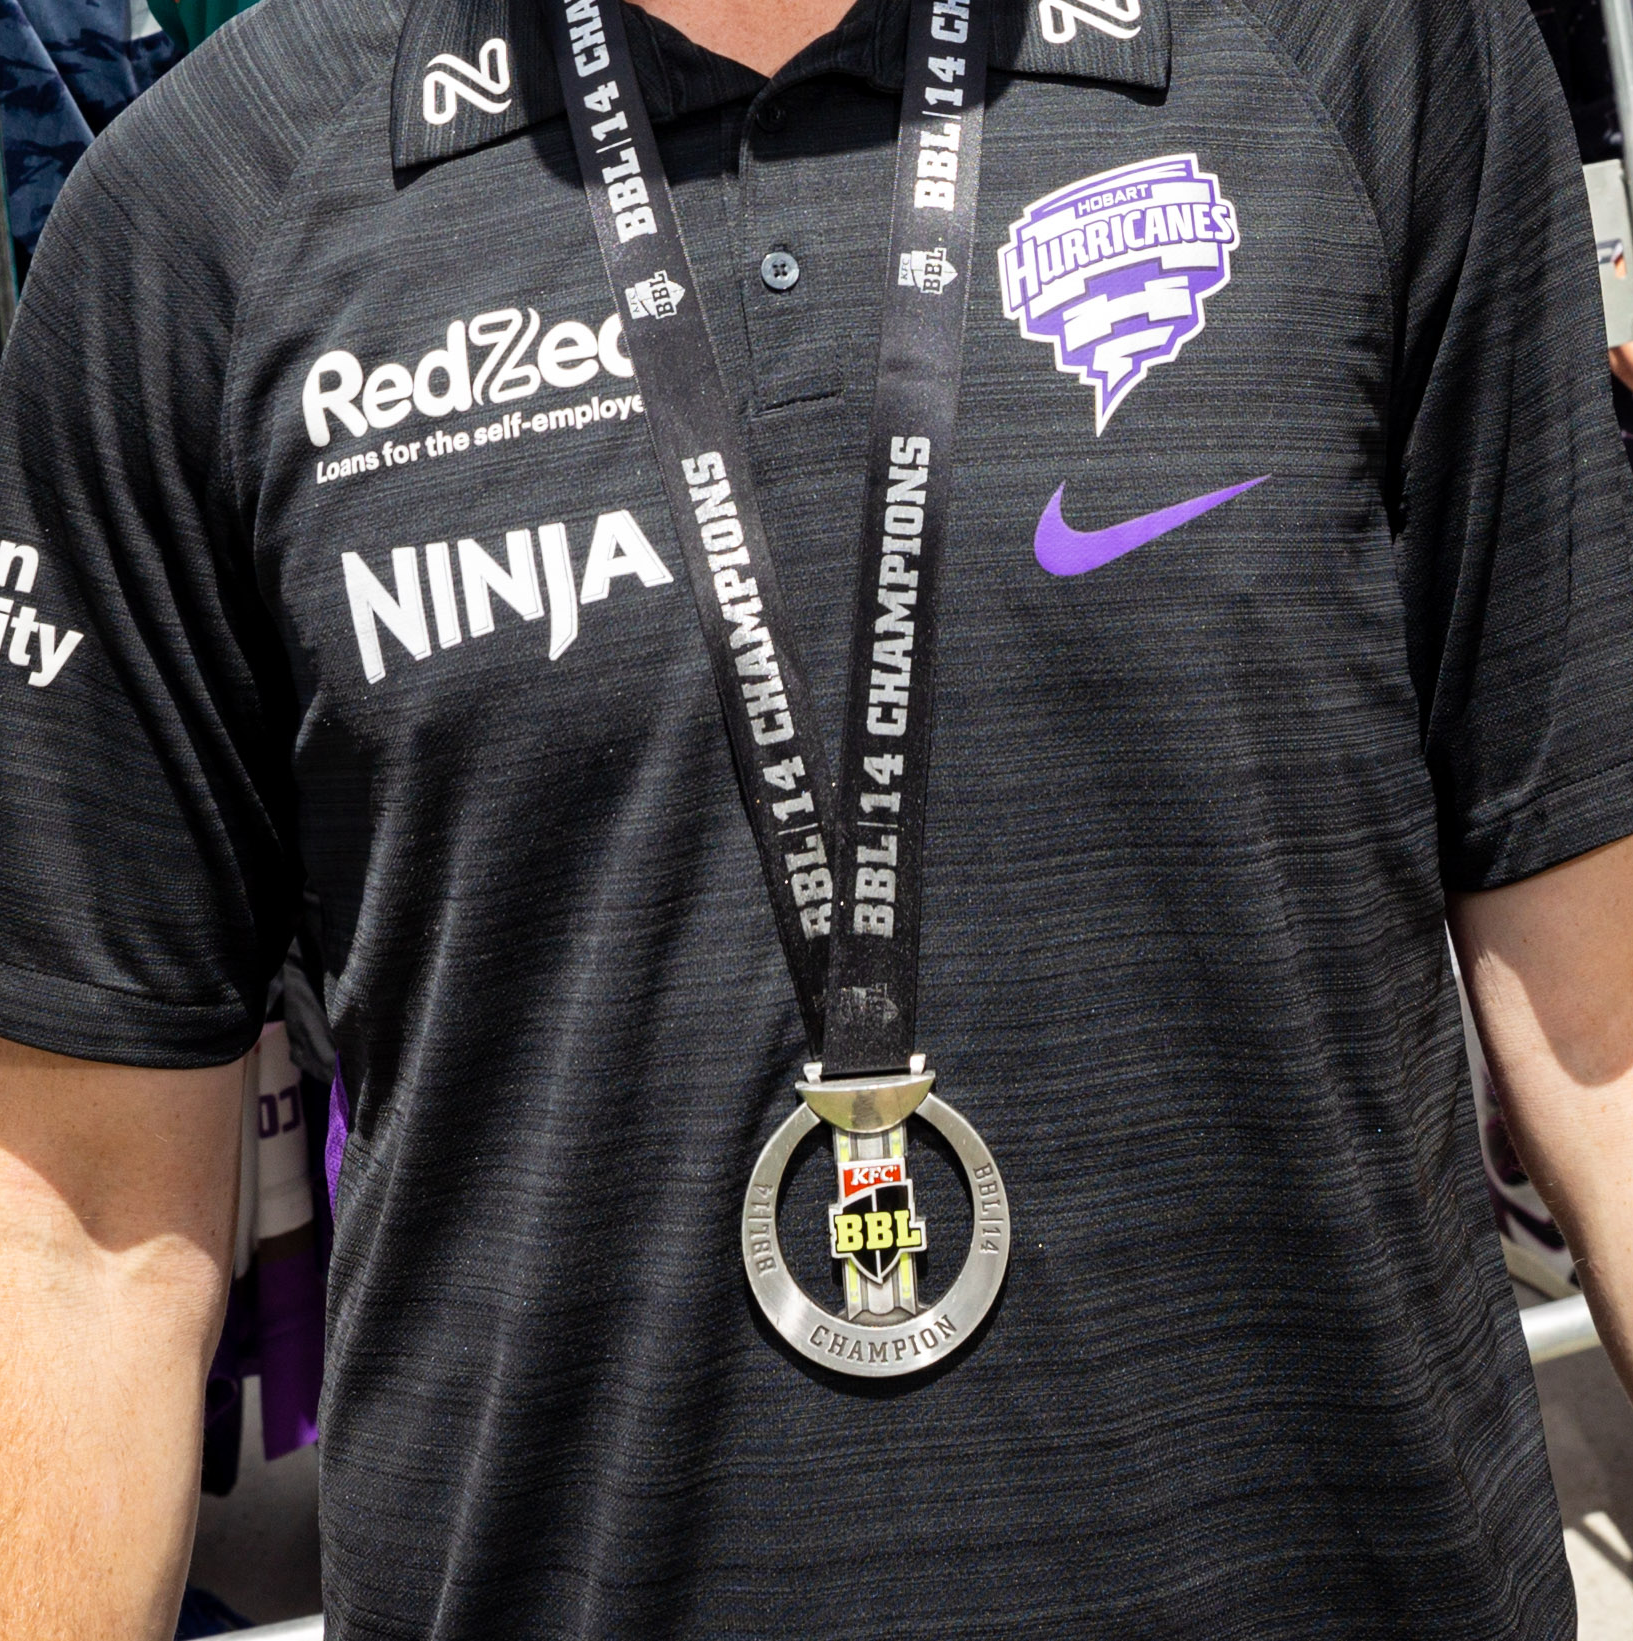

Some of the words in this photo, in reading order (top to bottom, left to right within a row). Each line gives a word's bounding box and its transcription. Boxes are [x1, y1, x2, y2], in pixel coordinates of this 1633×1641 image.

[1075, 183, 1149, 217] HOBART
[921, 247, 947, 294] BBL
[1005, 203, 1236, 312] HURRICANES
[649, 272, 677, 318] BBL
[316, 451, 380, 485] Loans
[381, 440, 421, 467] for
[425, 428, 471, 458] the
[473, 393, 645, 446] self-employe
[340, 508, 675, 685] NINJA
[680, 449, 796, 748] CHAMPIONS
[866, 435, 932, 738] CHAMPIONS
[850, 1167, 895, 1187] KFC
[834, 1209, 922, 1252] BBL
[807, 1313, 959, 1364] CHAMPION
